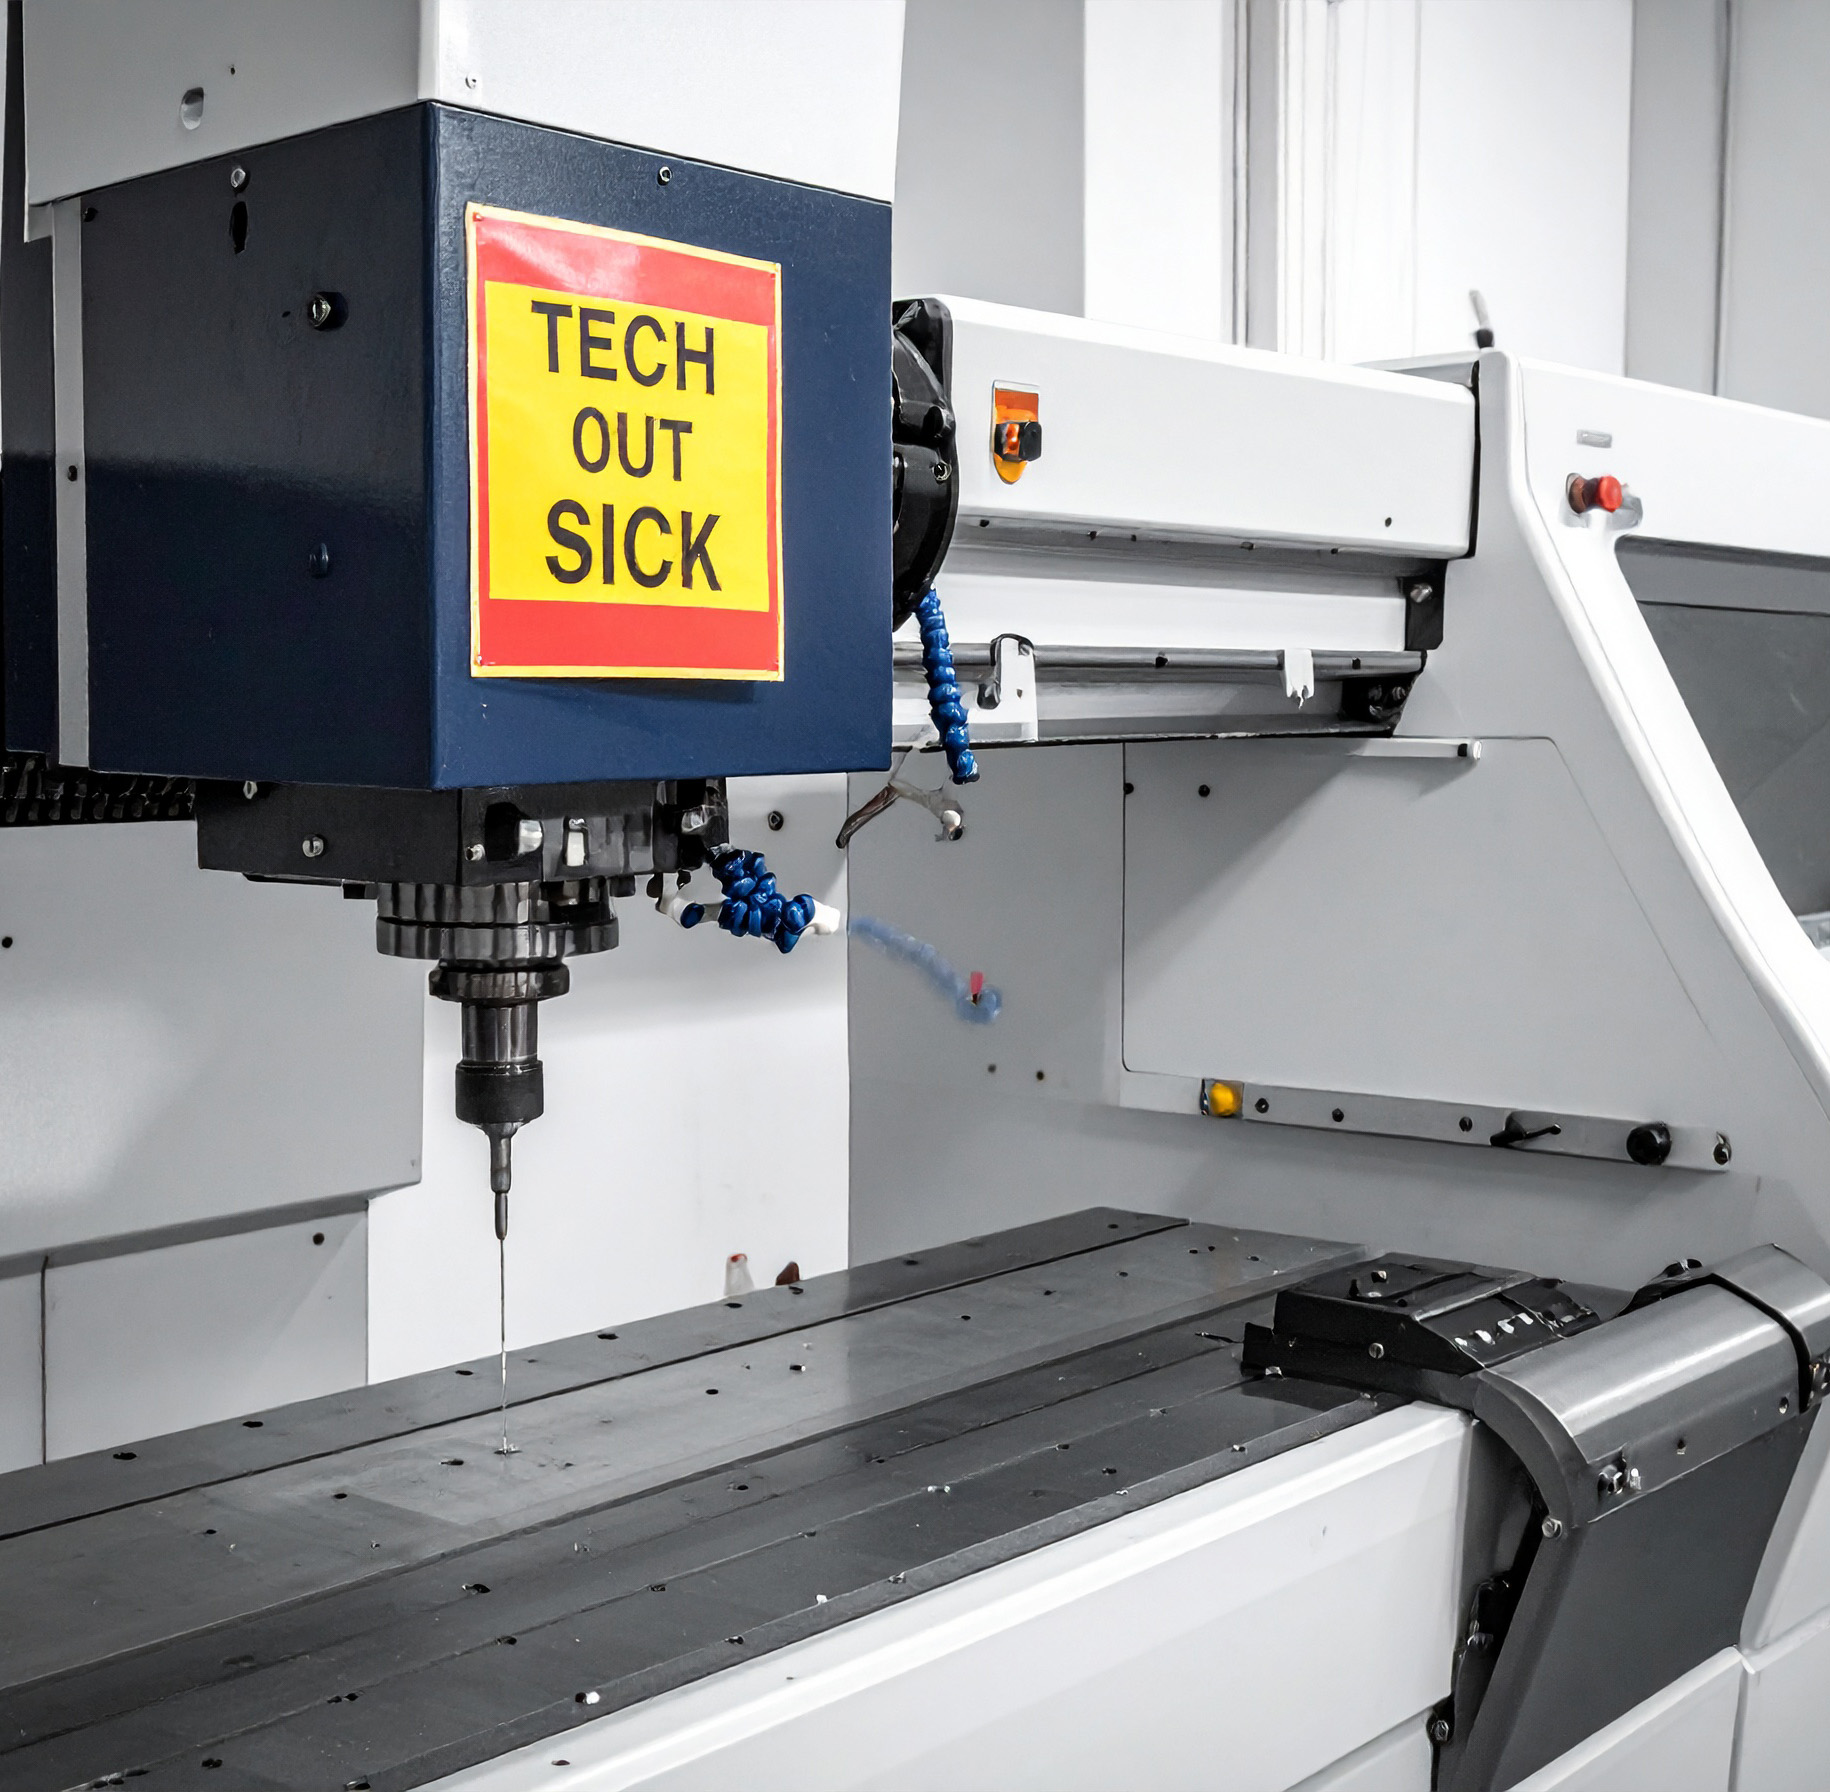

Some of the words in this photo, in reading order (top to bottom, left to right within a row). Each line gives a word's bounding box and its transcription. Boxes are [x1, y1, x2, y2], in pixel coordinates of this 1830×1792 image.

[531, 300, 715, 396] TECH
[572, 406, 693, 482] OUT
[545, 499, 722, 591] SICK
